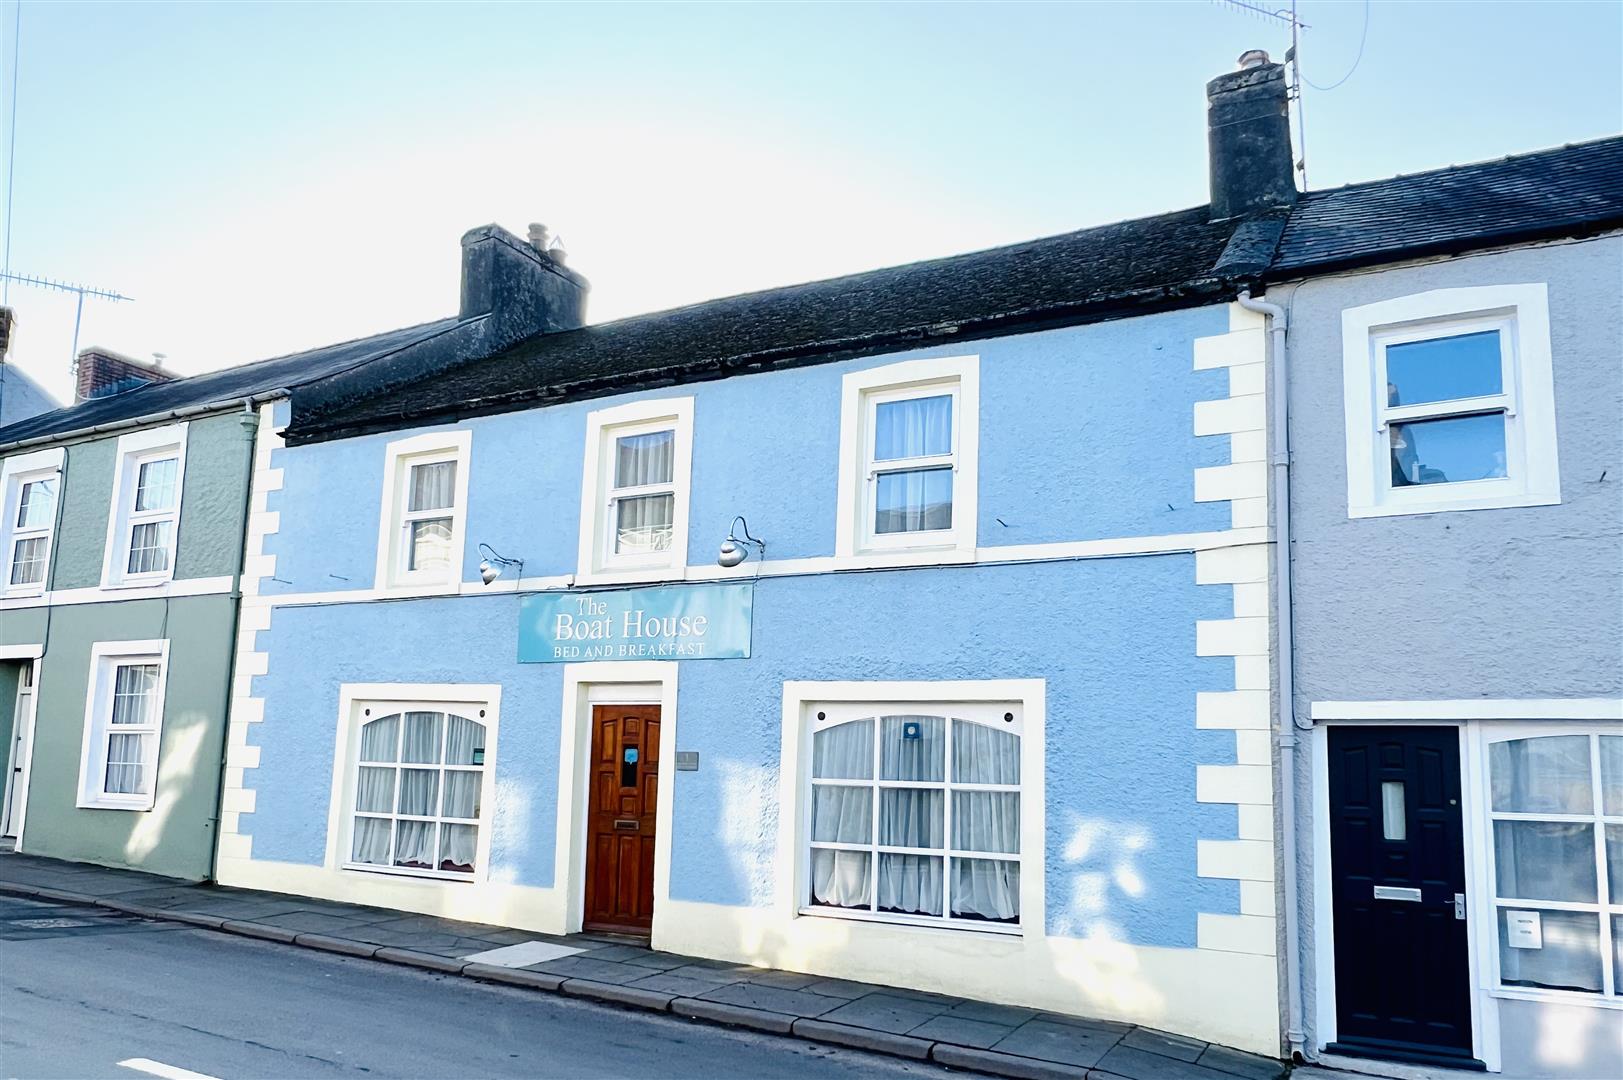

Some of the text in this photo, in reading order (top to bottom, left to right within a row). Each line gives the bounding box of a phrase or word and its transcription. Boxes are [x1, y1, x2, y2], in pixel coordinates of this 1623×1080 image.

[576, 596, 608, 616] The
[555, 610, 708, 640] Boat House
[554, 642, 705, 659] BED AND BREAKFAST
